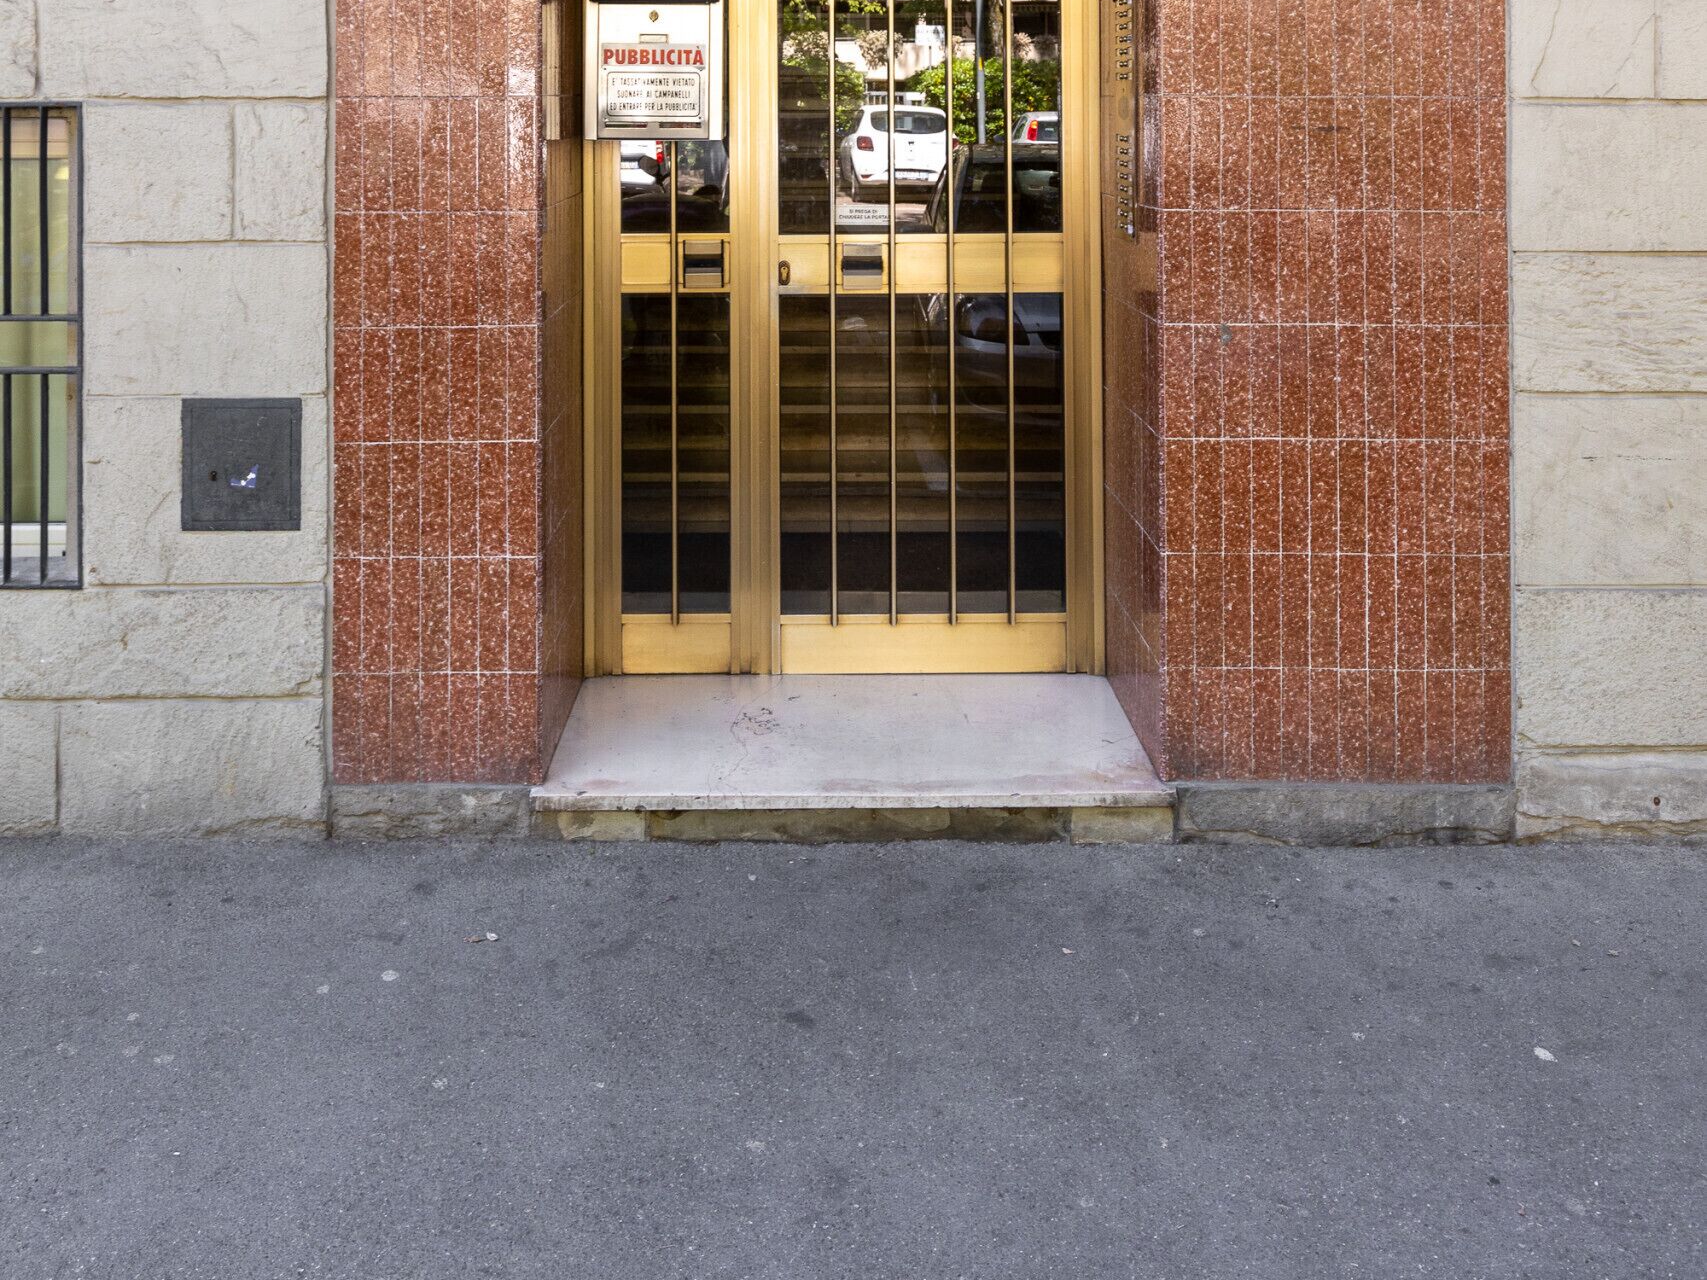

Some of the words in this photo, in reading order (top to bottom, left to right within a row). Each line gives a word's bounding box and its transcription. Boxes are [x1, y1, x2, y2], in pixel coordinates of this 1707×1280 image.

[603, 45, 704, 65] PUBBLICITÀ
[672, 77, 695, 86] VIETATO
[655, 90, 691, 99] CAMPANELLI
[609, 102, 617, 111] ED
[618, 102, 643, 111] ENTRARE
[645, 102, 655, 111] PER
[656, 102, 663, 111] LA
